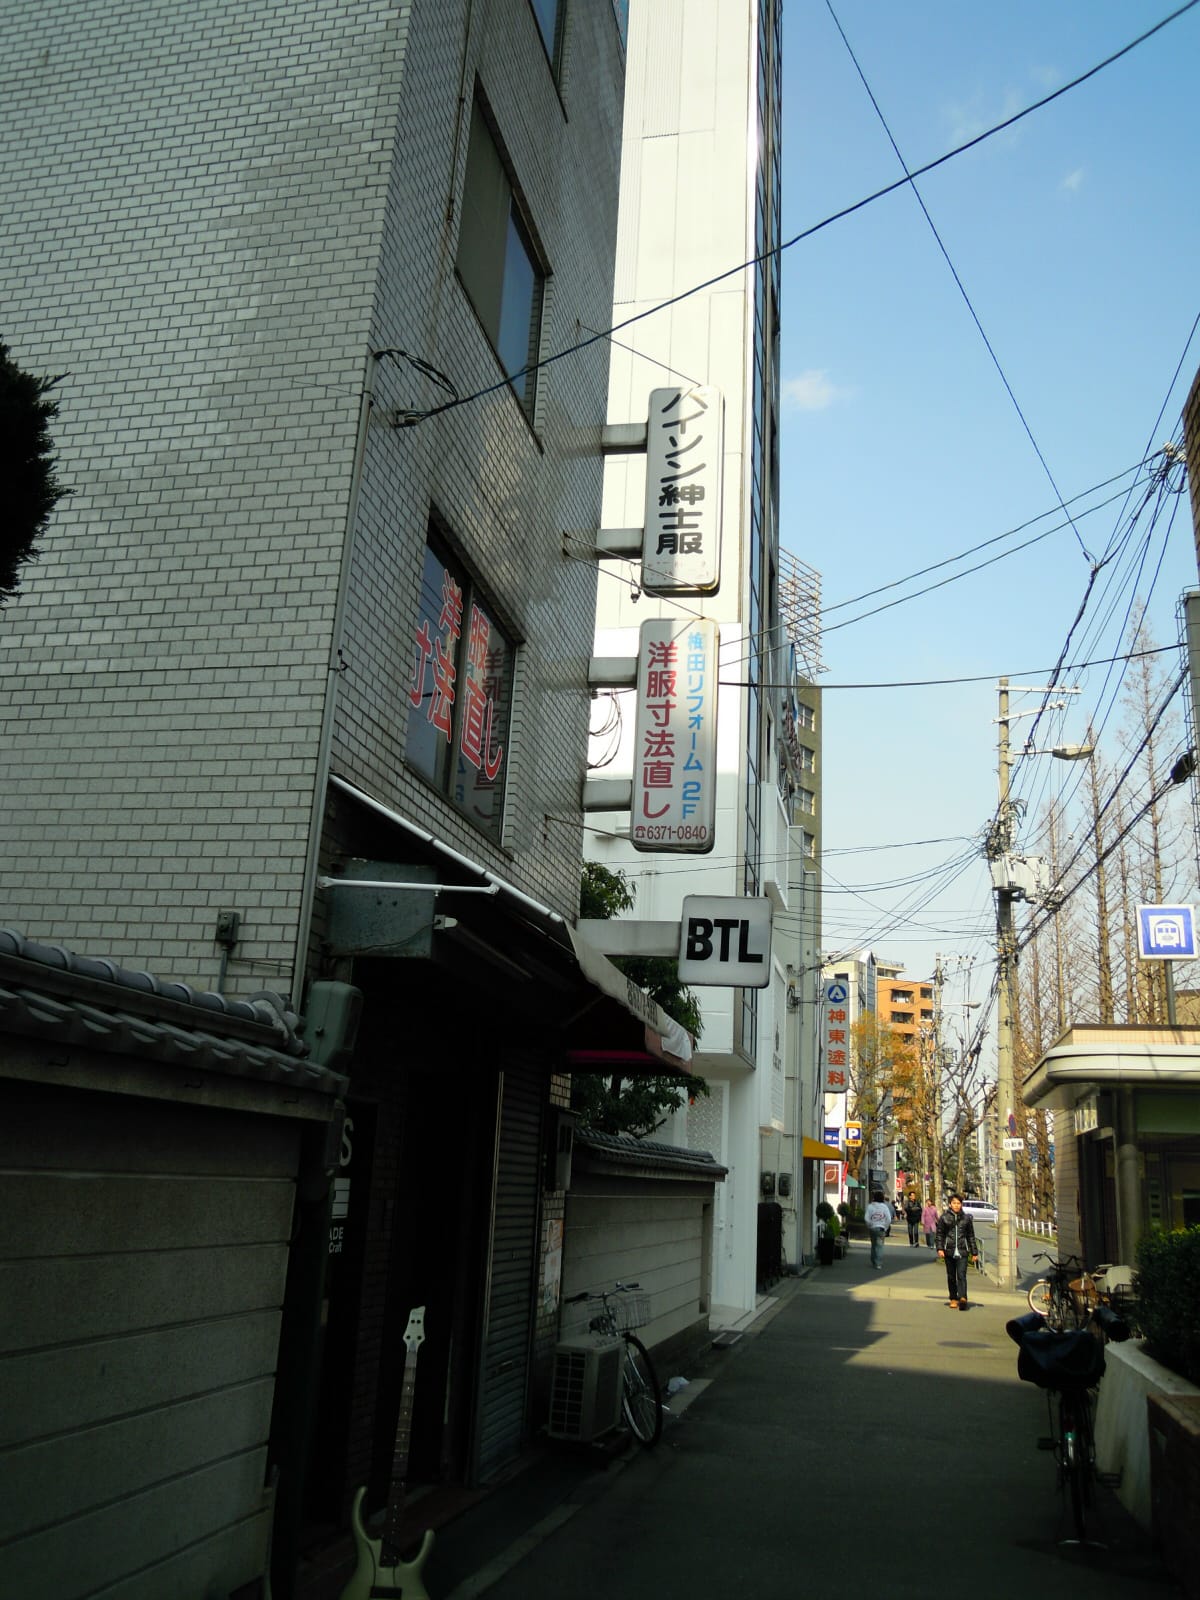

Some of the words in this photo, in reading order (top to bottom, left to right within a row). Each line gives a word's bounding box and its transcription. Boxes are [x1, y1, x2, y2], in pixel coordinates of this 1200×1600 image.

[643, 641, 678, 819] 洋服寸法直し
[646, 825, 707, 840] 6371-0840
[686, 917, 763, 963] BTL
[827, 1008, 846, 1086] 神東塗料
[848, 1128, 859, 1139] P
